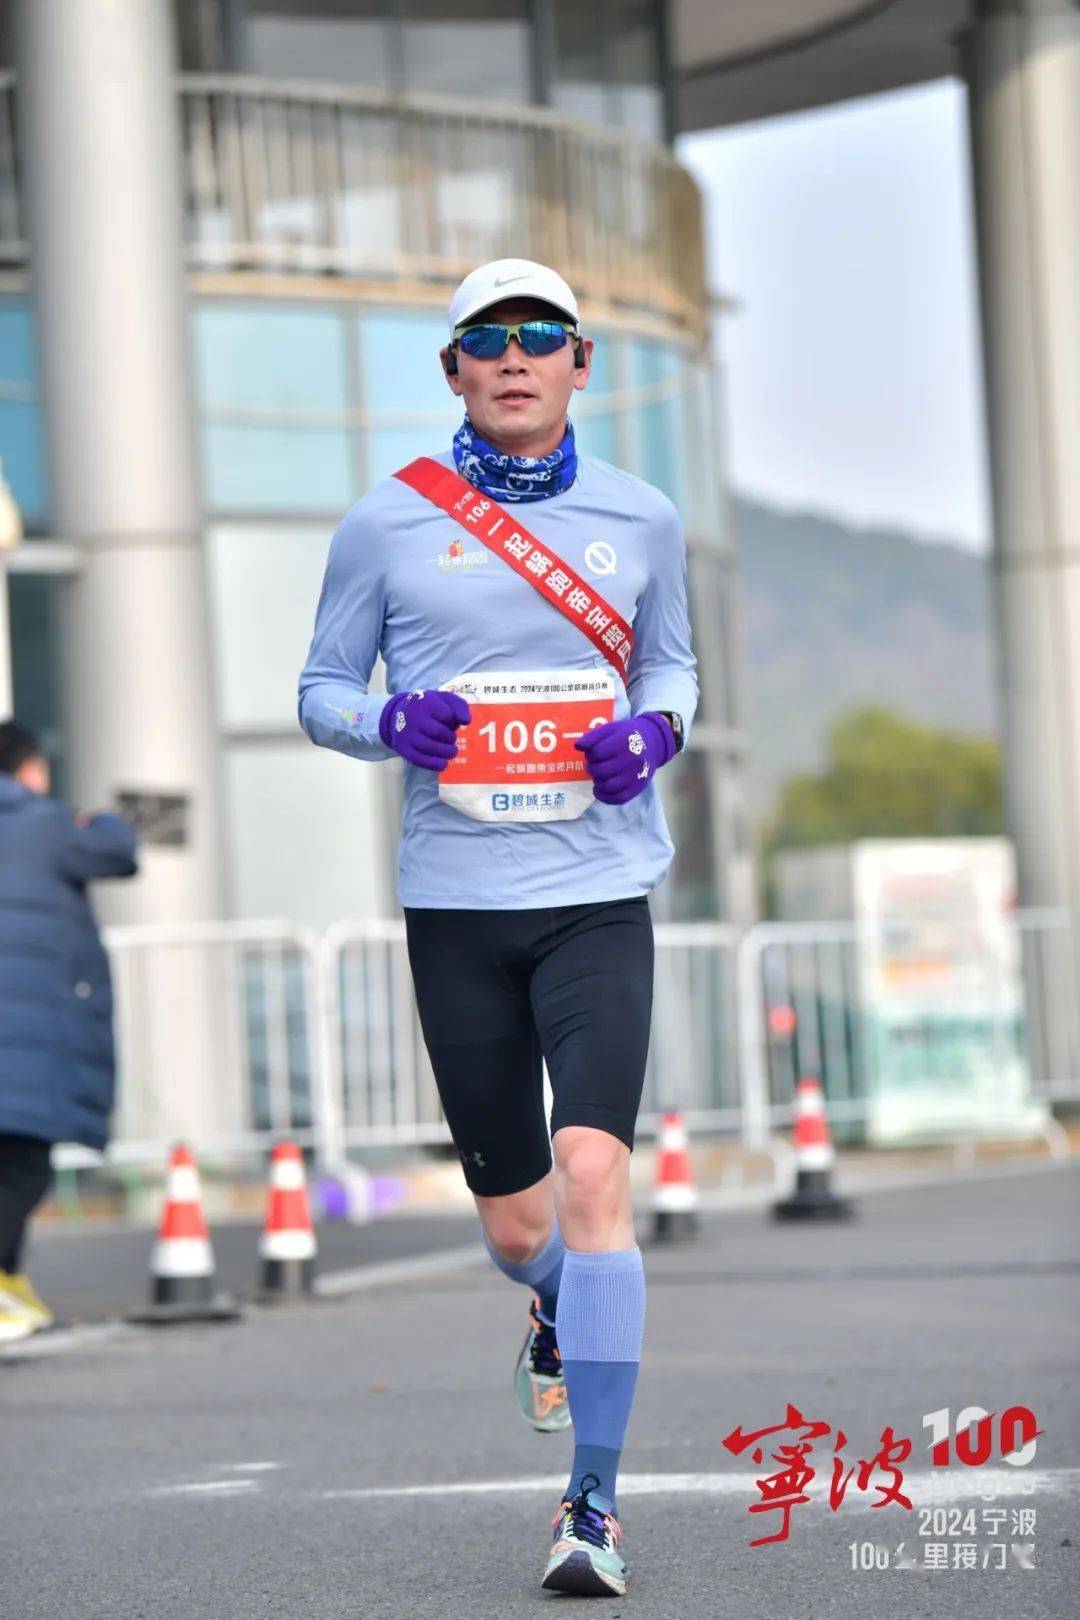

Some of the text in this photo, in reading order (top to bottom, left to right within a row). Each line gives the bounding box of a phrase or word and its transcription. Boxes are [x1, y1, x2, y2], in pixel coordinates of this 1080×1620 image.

[466, 500, 491, 523] 106
[512, 792, 566, 807] 碧城生态
